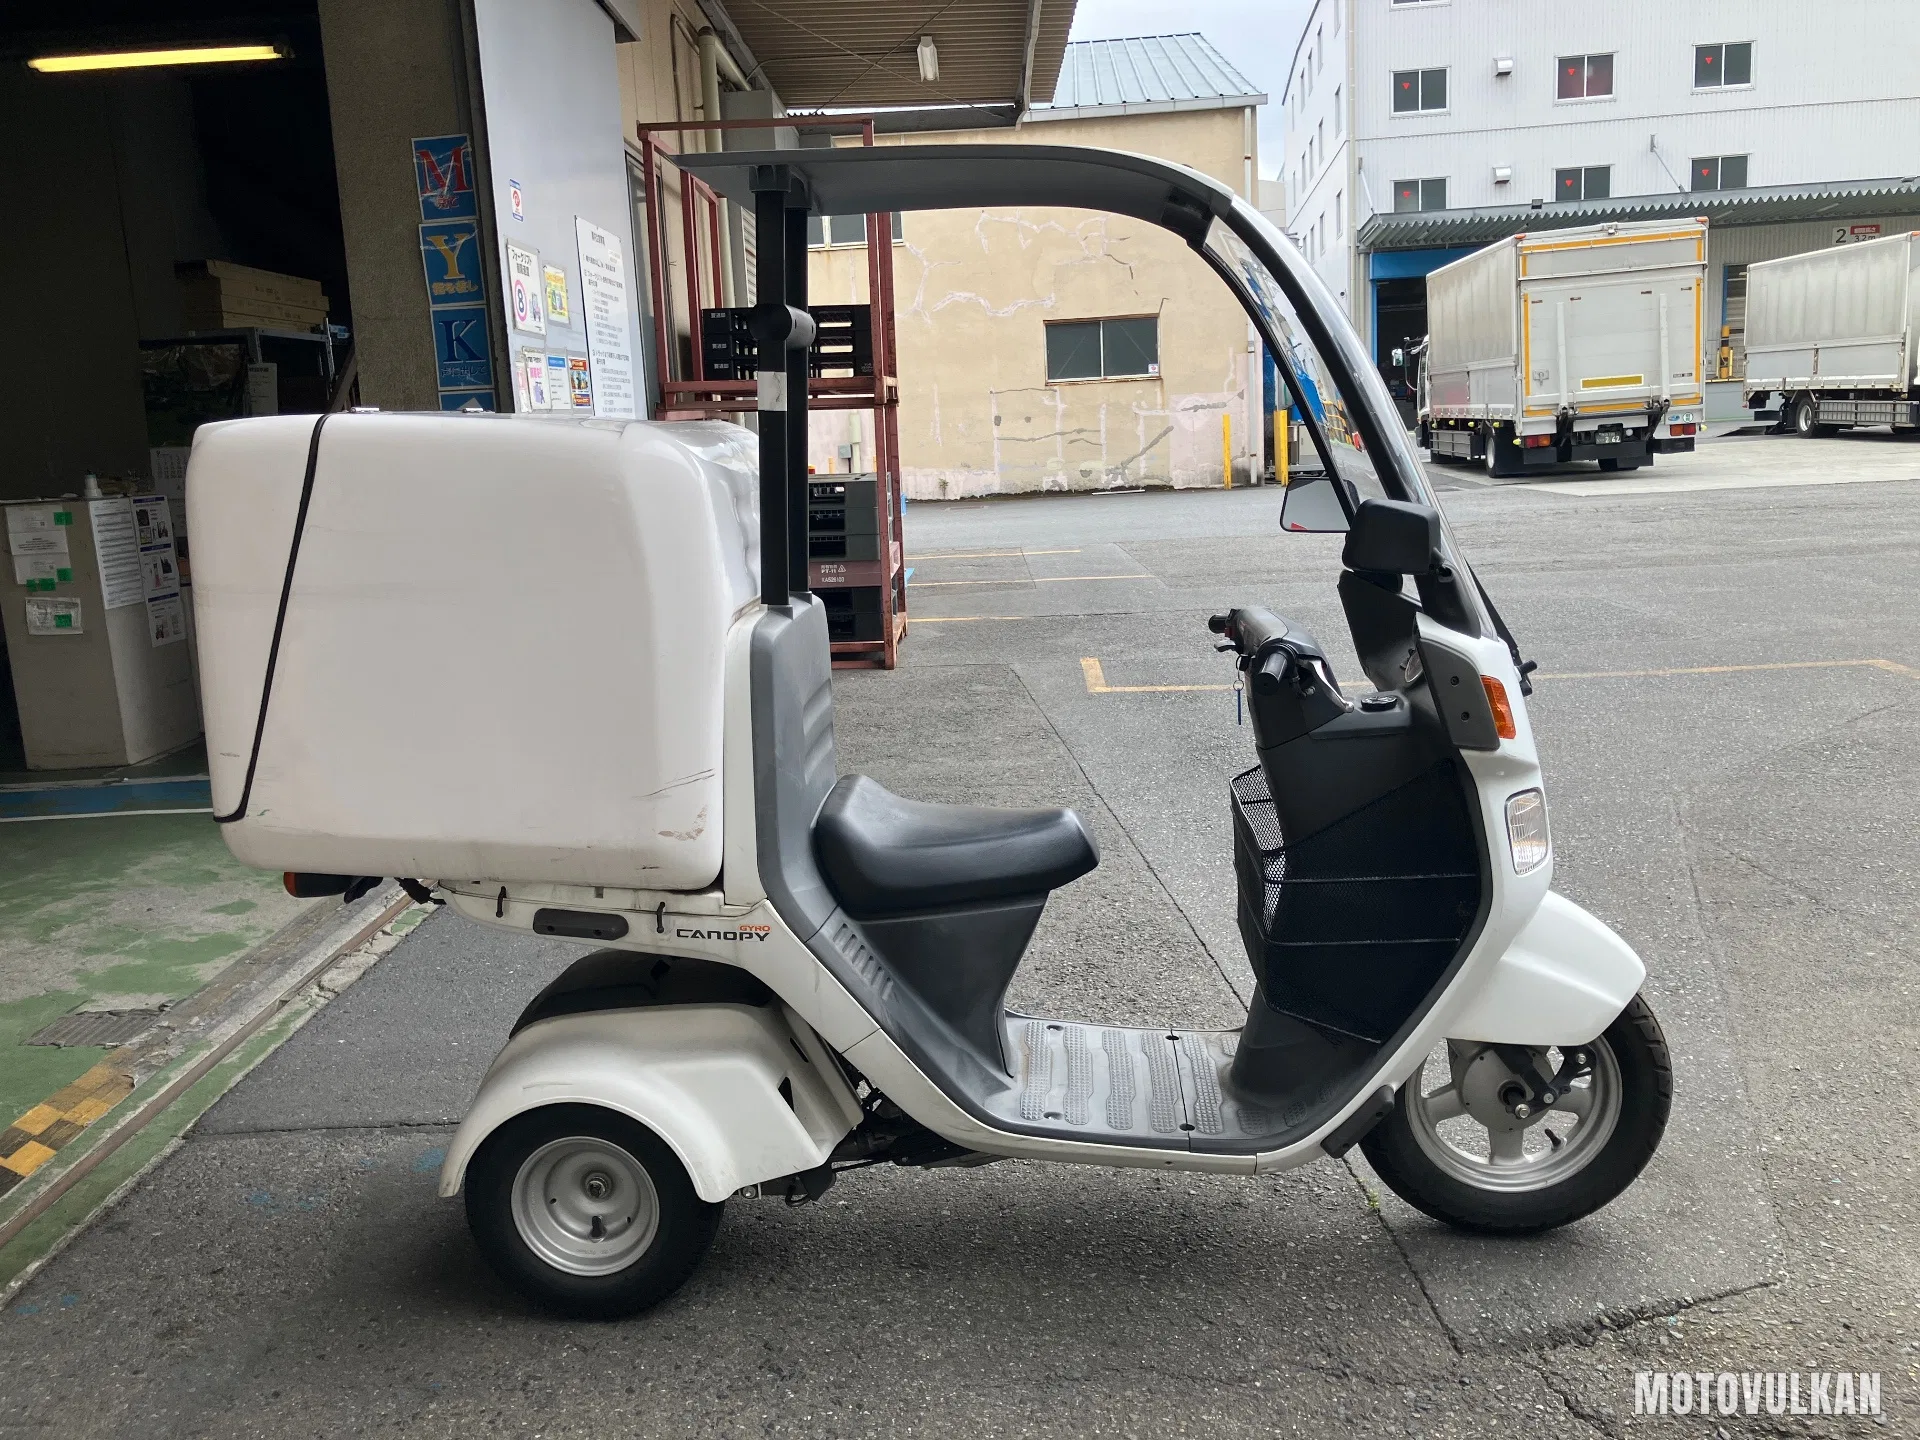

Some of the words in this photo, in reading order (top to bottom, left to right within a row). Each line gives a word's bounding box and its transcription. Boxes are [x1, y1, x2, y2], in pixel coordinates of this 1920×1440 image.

[416, 147, 472, 197] M
[1836, 229, 1847, 243] 2
[426, 233, 470, 279] Y
[517, 288, 525, 313] 8
[439, 319, 487, 363] K
[677, 929, 770, 941] CANOPY
